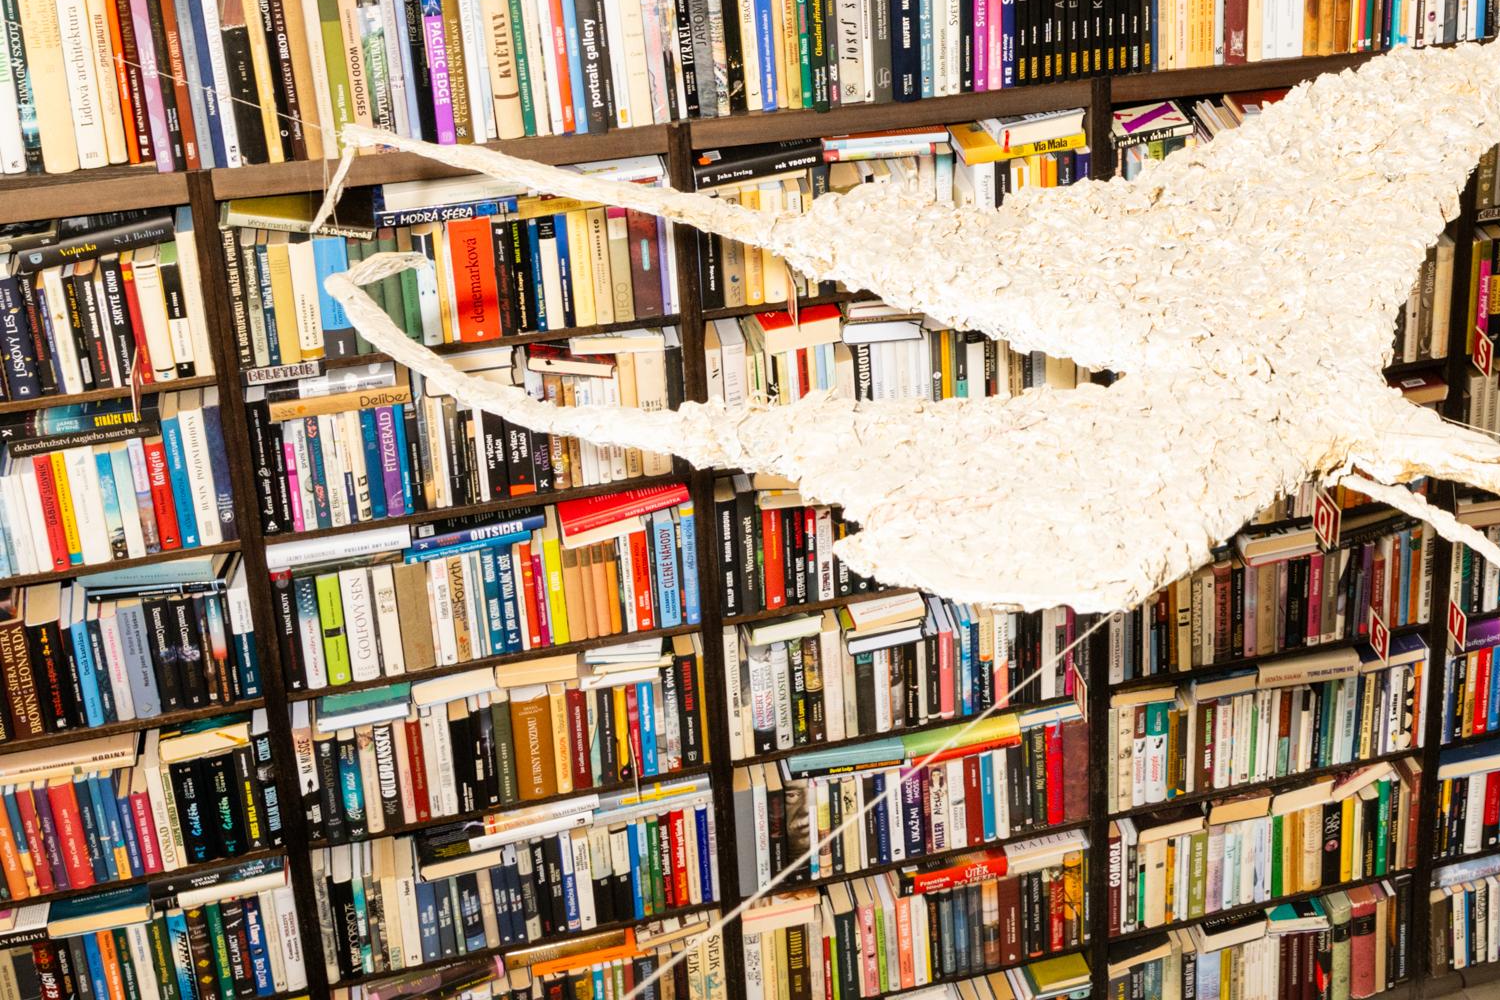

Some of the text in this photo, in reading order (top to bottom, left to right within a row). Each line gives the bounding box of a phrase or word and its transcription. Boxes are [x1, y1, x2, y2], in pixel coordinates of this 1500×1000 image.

[428, 21, 451, 105] PACIFIC EDGE
[492, 12, 512, 80] KVĚTINY
[582, 18, 604, 109] portrait gallery
[841, 21, 860, 64] josef
[349, 46, 367, 117] WOOD HOUSES
[400, 211, 439, 224] MODRÁ
[105, 270, 125, 326] SKRYTÉ OKNO
[470, 236, 485, 324] denemarková
[248, 363, 315, 382] BELETRIE
[1477, 339, 1487, 368] S
[377, 412, 398, 474] FITZGERALD
[1374, 628, 1384, 652] S
[1452, 613, 1461, 635] V
[933, 821, 945, 855] MILLER
[1108, 841, 1122, 888] GOMORA
